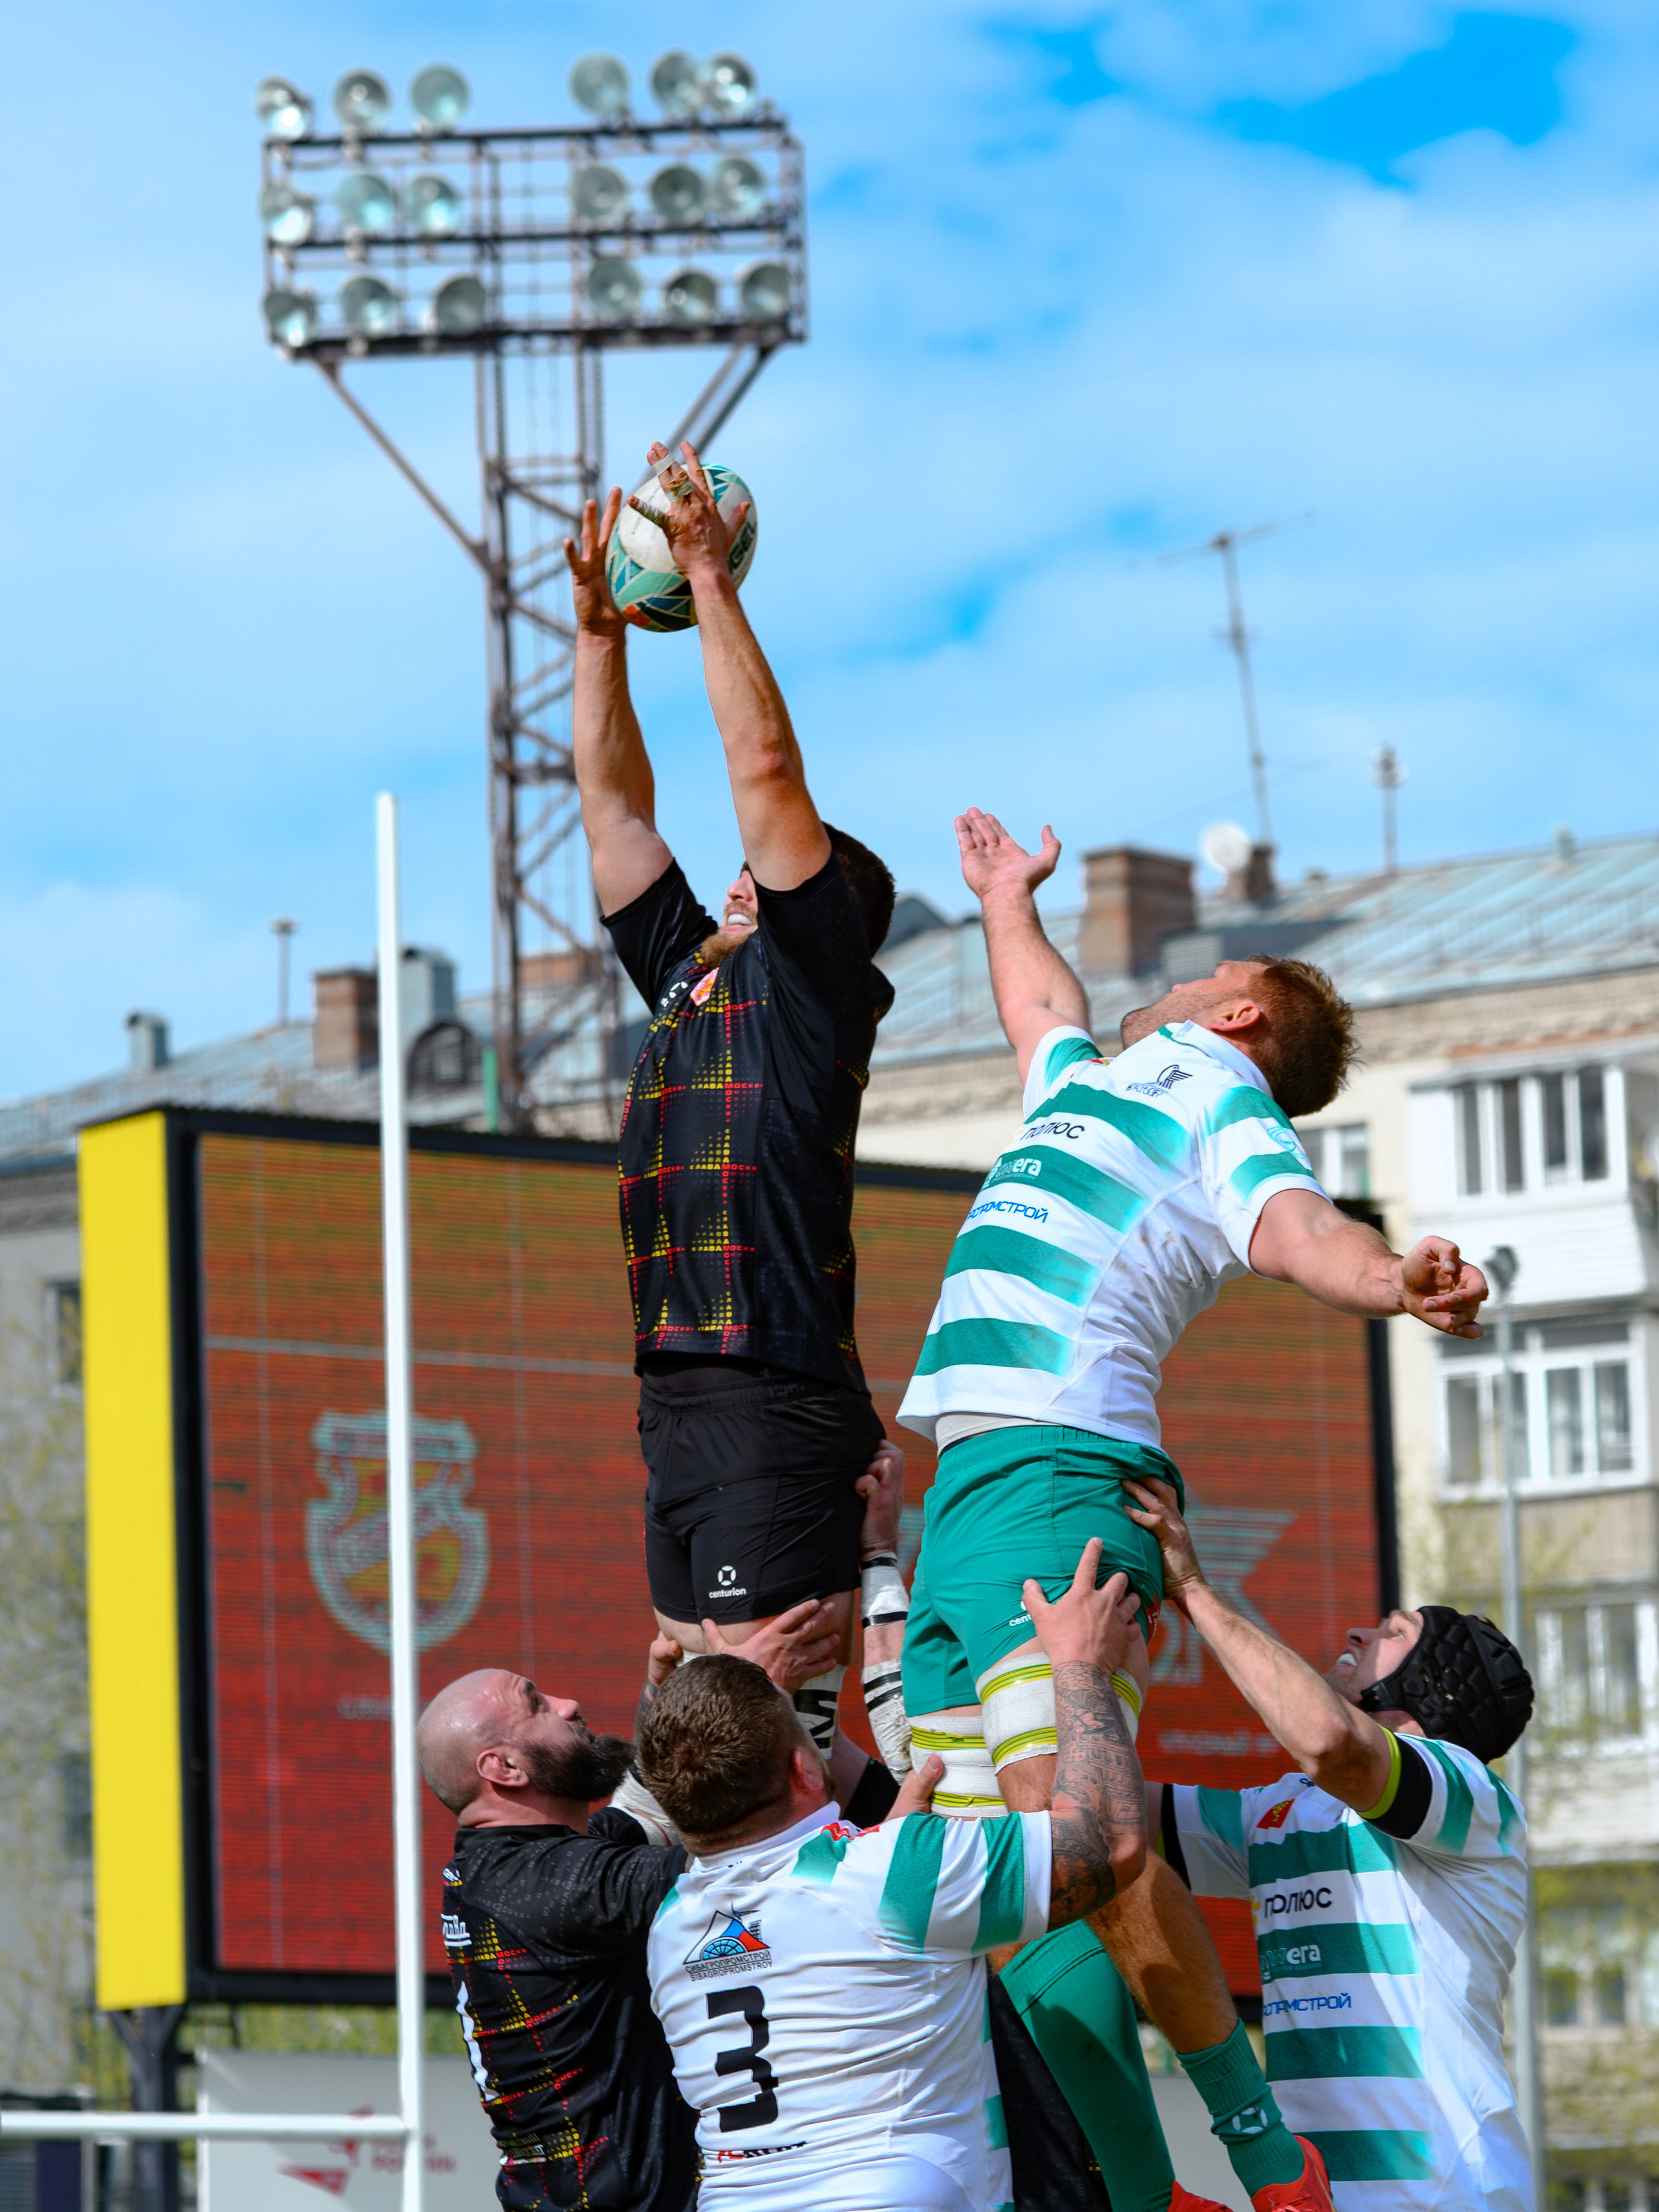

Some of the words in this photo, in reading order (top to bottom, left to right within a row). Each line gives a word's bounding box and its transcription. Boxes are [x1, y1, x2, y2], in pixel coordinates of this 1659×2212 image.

[708, 1587, 747, 1599] centurion
[684, 1950, 772, 1973] СИБАГРОПРОМСТРОЙ
[690, 1961, 772, 1982] SIBAGROPROMSTROY
[706, 1985, 779, 2134] 3
